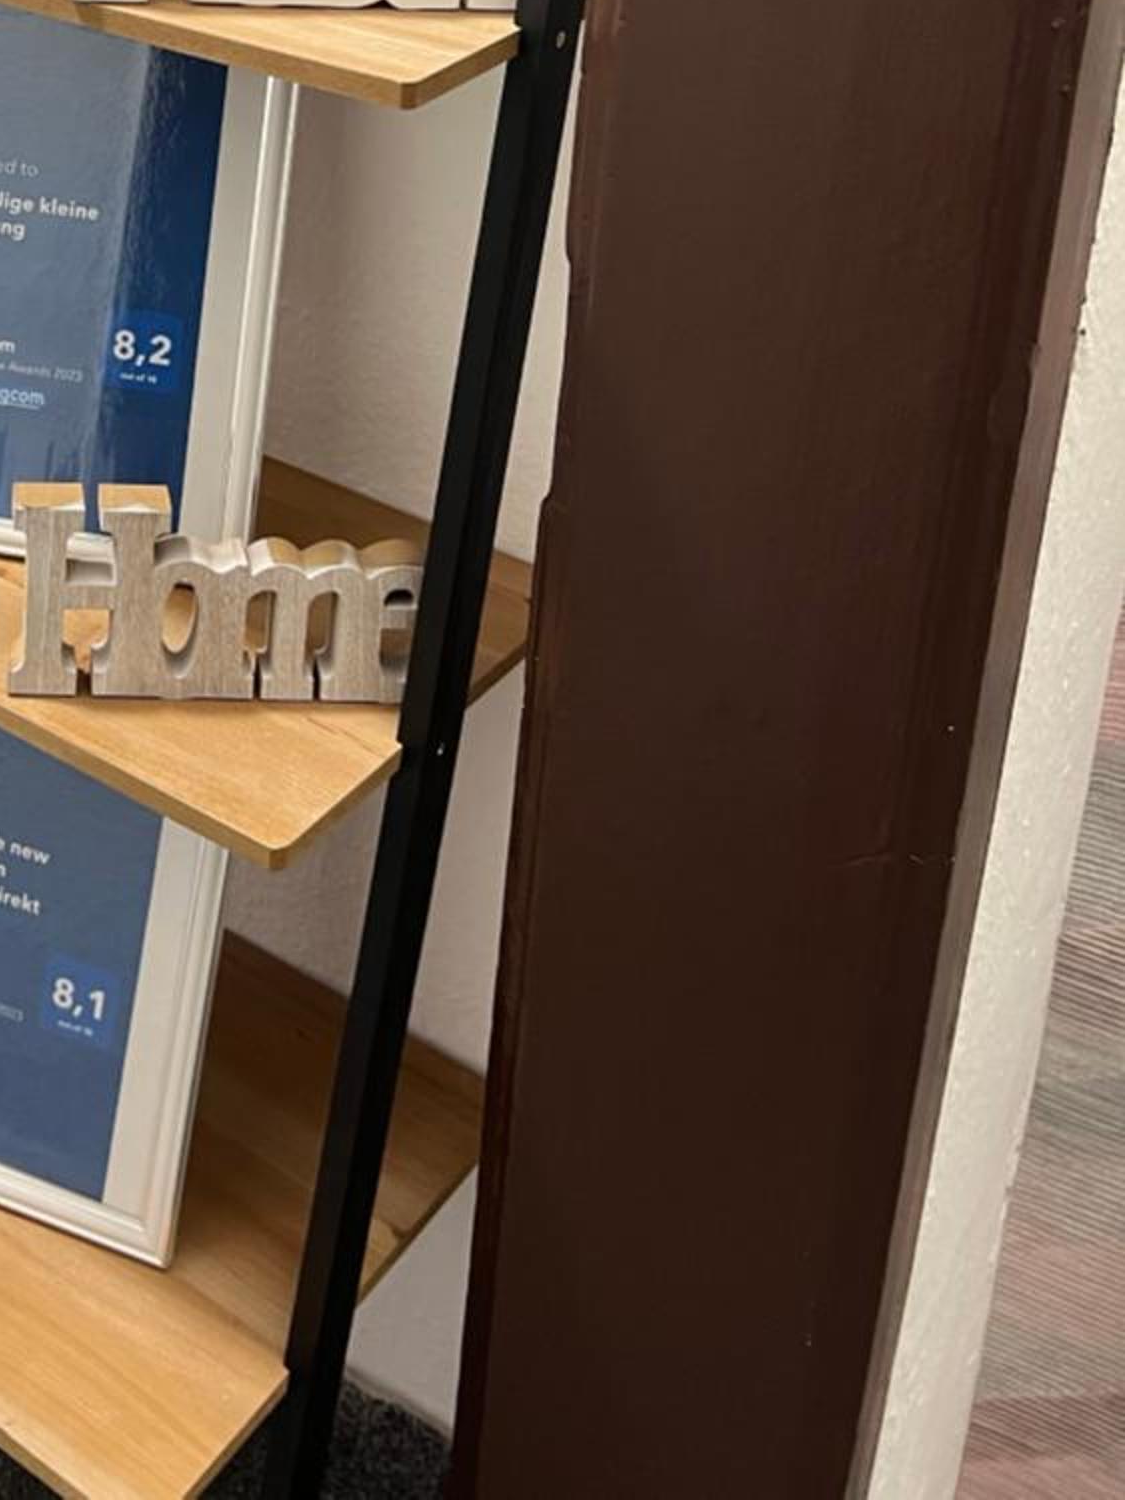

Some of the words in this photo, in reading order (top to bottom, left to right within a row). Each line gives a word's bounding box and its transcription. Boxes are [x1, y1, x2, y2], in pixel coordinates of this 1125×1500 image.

[20, 162, 39, 178] to
[39, 196, 100, 221] kleine
[113, 329, 172, 367] 8,2
[8, 482, 424, 704] Home
[9, 841, 51, 866] new
[52, 977, 105, 1020] 8,1
